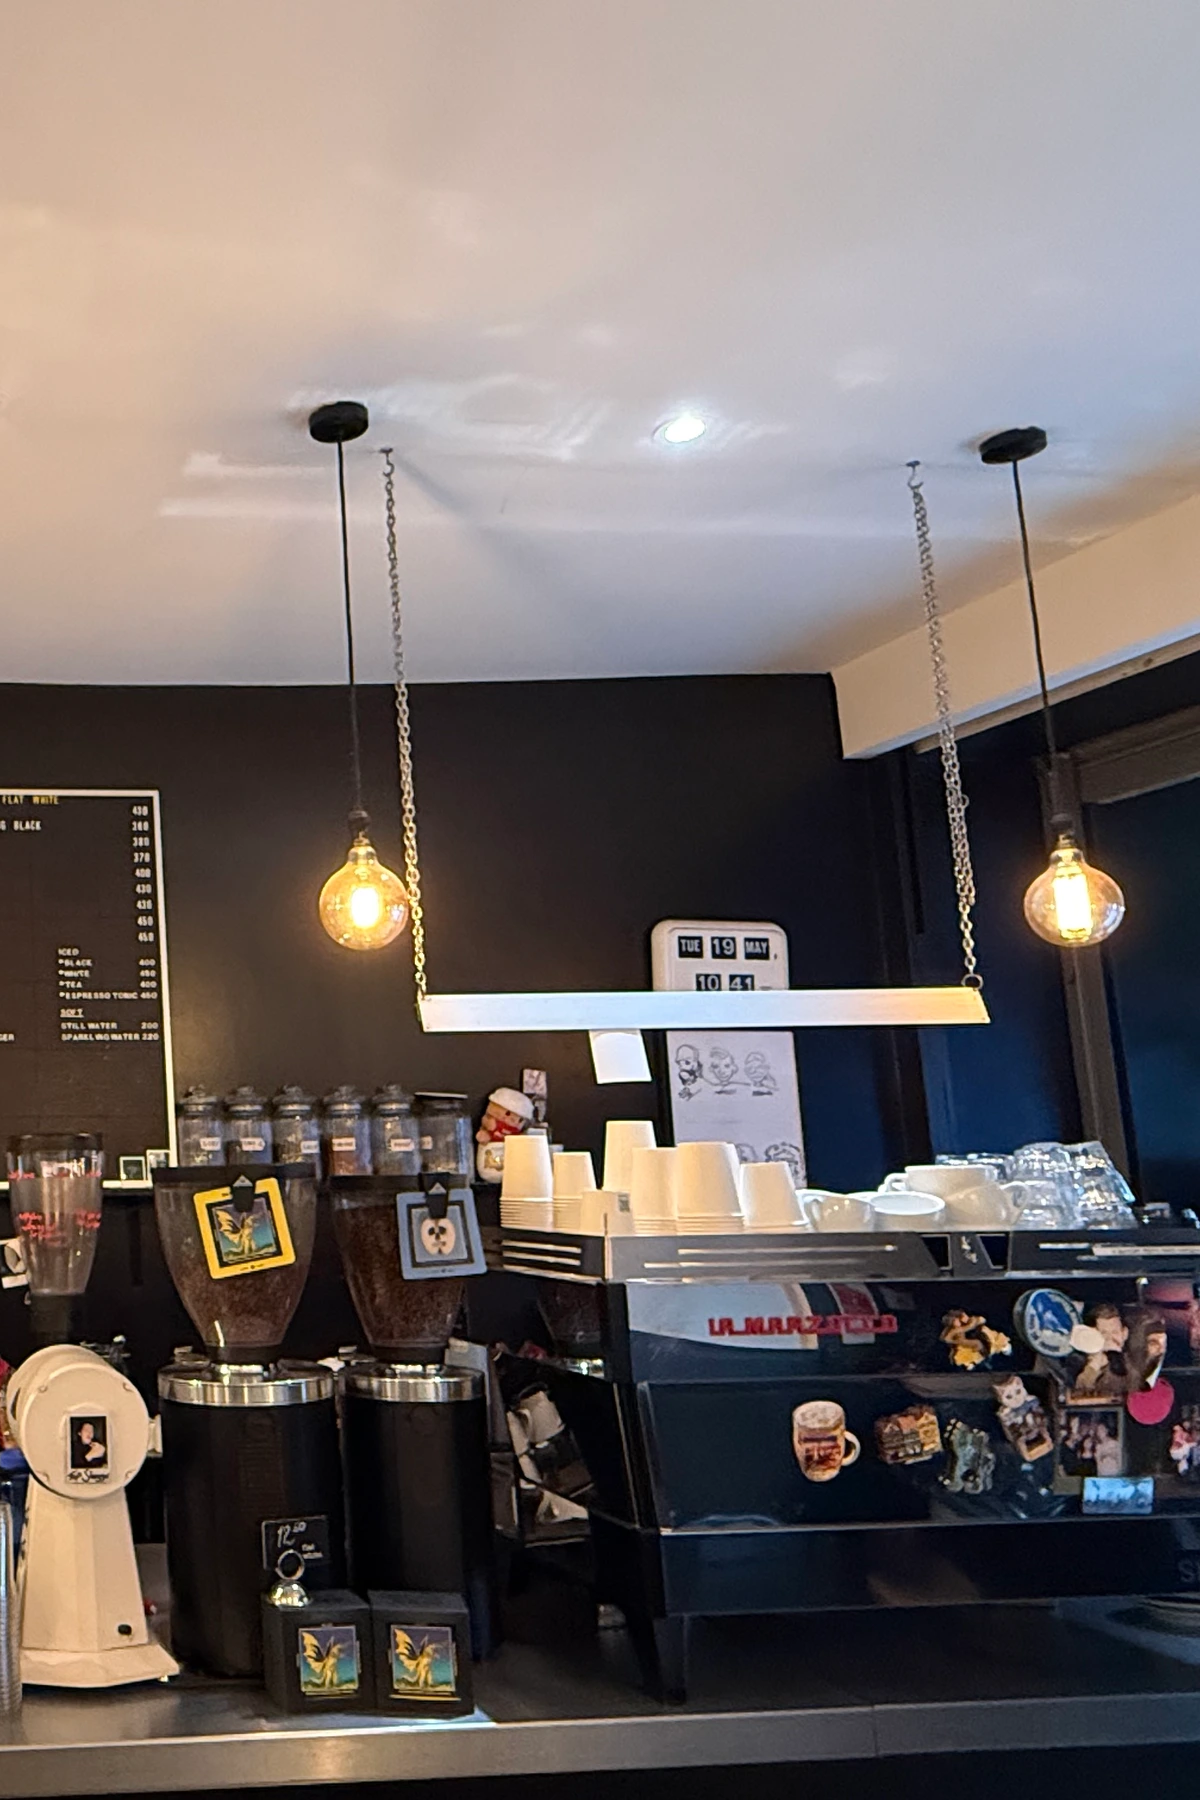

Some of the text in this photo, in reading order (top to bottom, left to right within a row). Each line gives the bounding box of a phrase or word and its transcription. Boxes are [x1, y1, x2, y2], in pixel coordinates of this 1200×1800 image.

[2, 795, 60, 805] FLAT WHITE
[13, 820, 41, 831] BLACK
[680, 938, 768, 955] TUE 19 MAY
[699, 975, 752, 991] 10 41
[61, 1022, 159, 1030] STILL WATER 200
[111, 1033, 140, 1041] WATER
